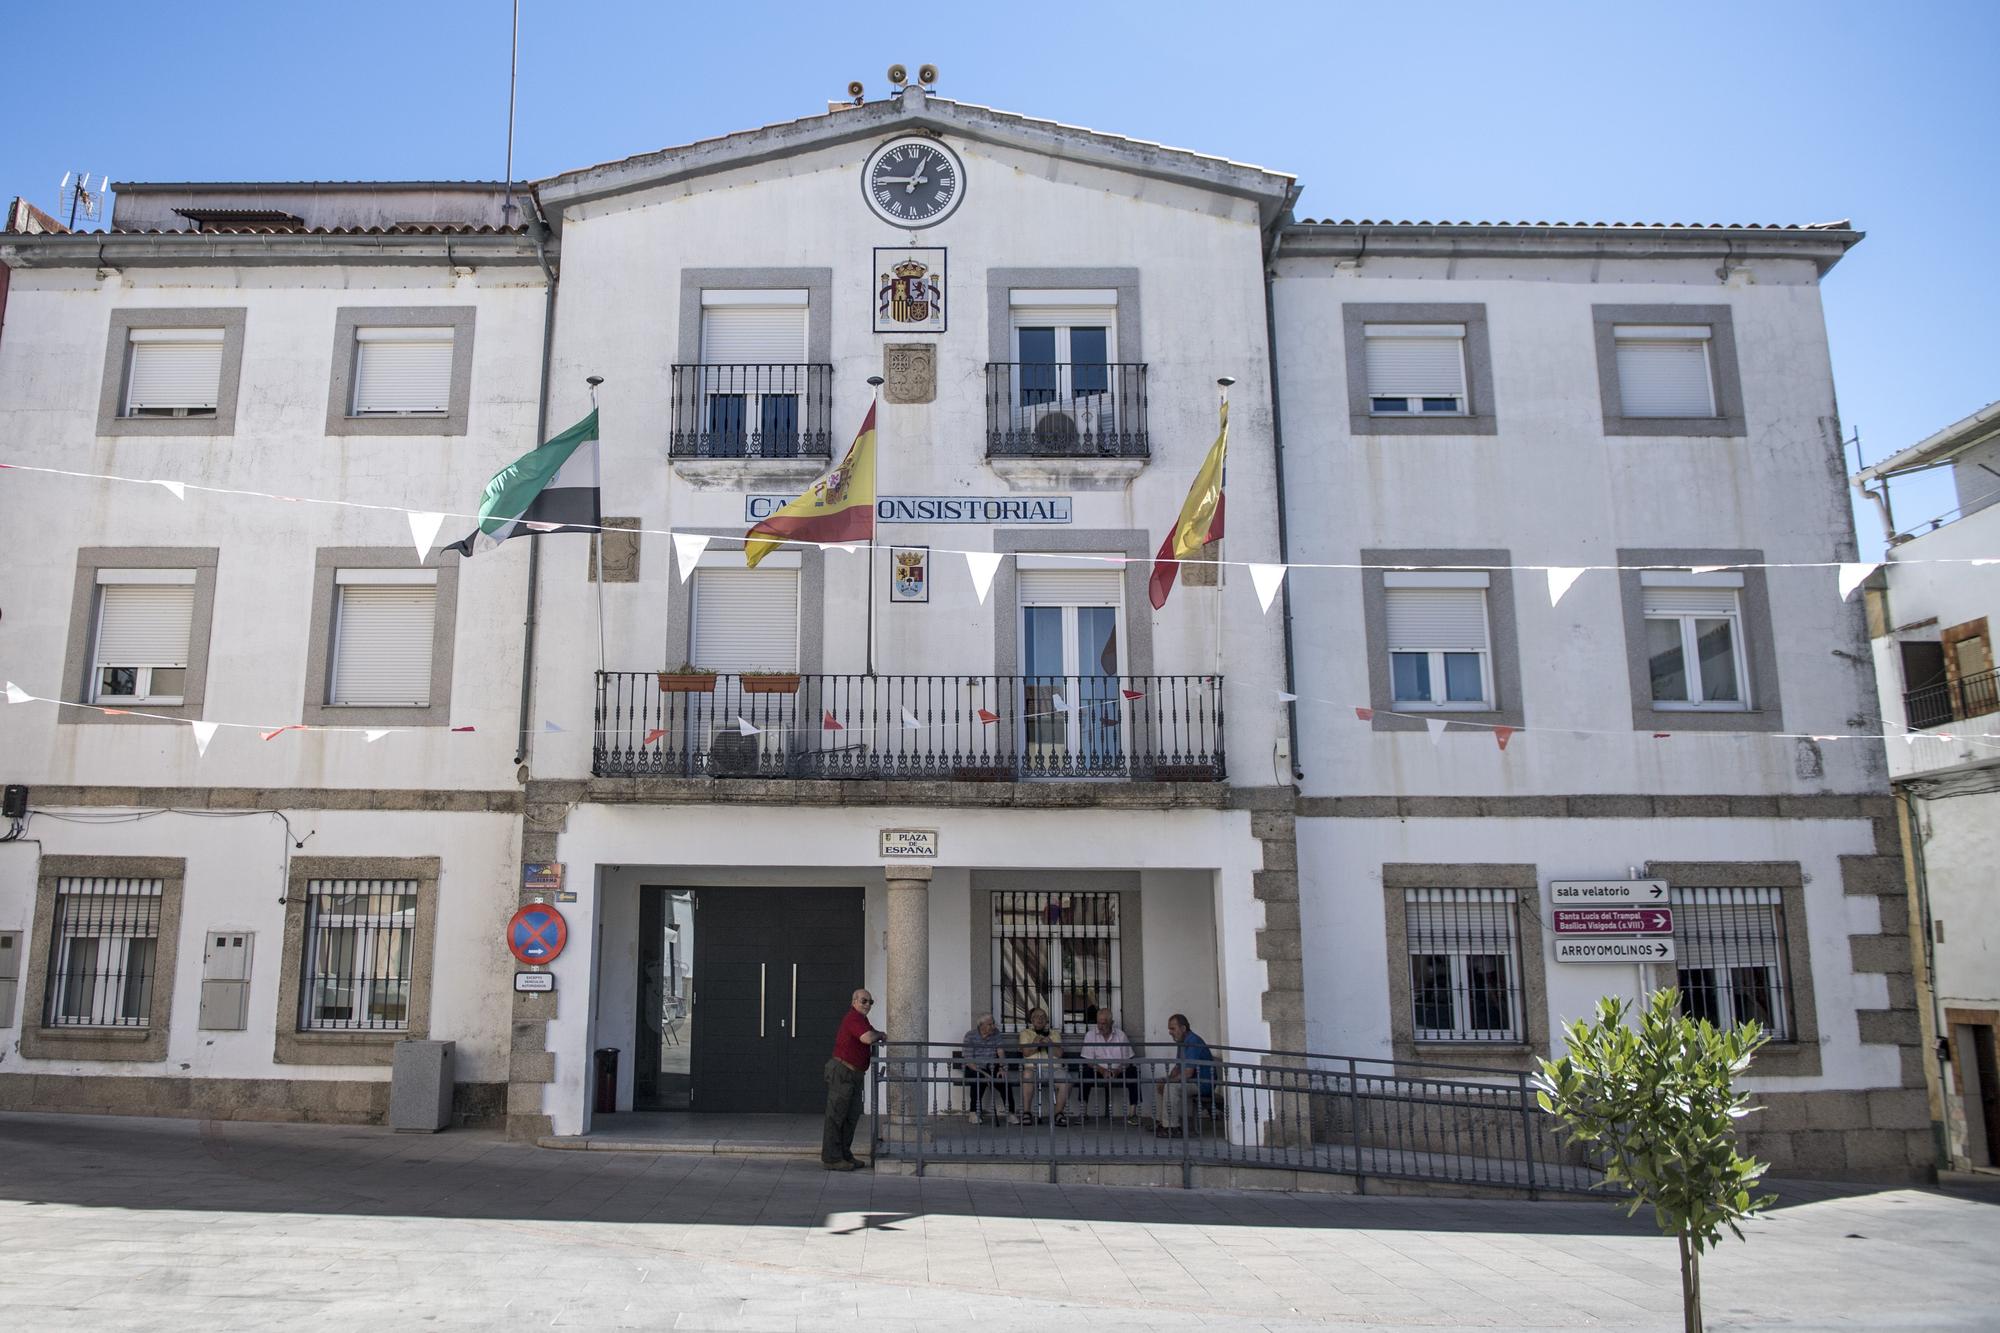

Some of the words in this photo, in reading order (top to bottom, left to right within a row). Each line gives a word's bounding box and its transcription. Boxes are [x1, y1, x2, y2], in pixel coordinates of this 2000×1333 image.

[886, 846, 932, 854] ESPAÑA
[1557, 886, 1579, 896] sala
[1582, 886, 1629, 896] velatorio
[1613, 912, 1641, 920] Trampal
[1588, 922, 1617, 930] Visigoda
[1562, 945, 1652, 956] ARROYOMOLINOS
